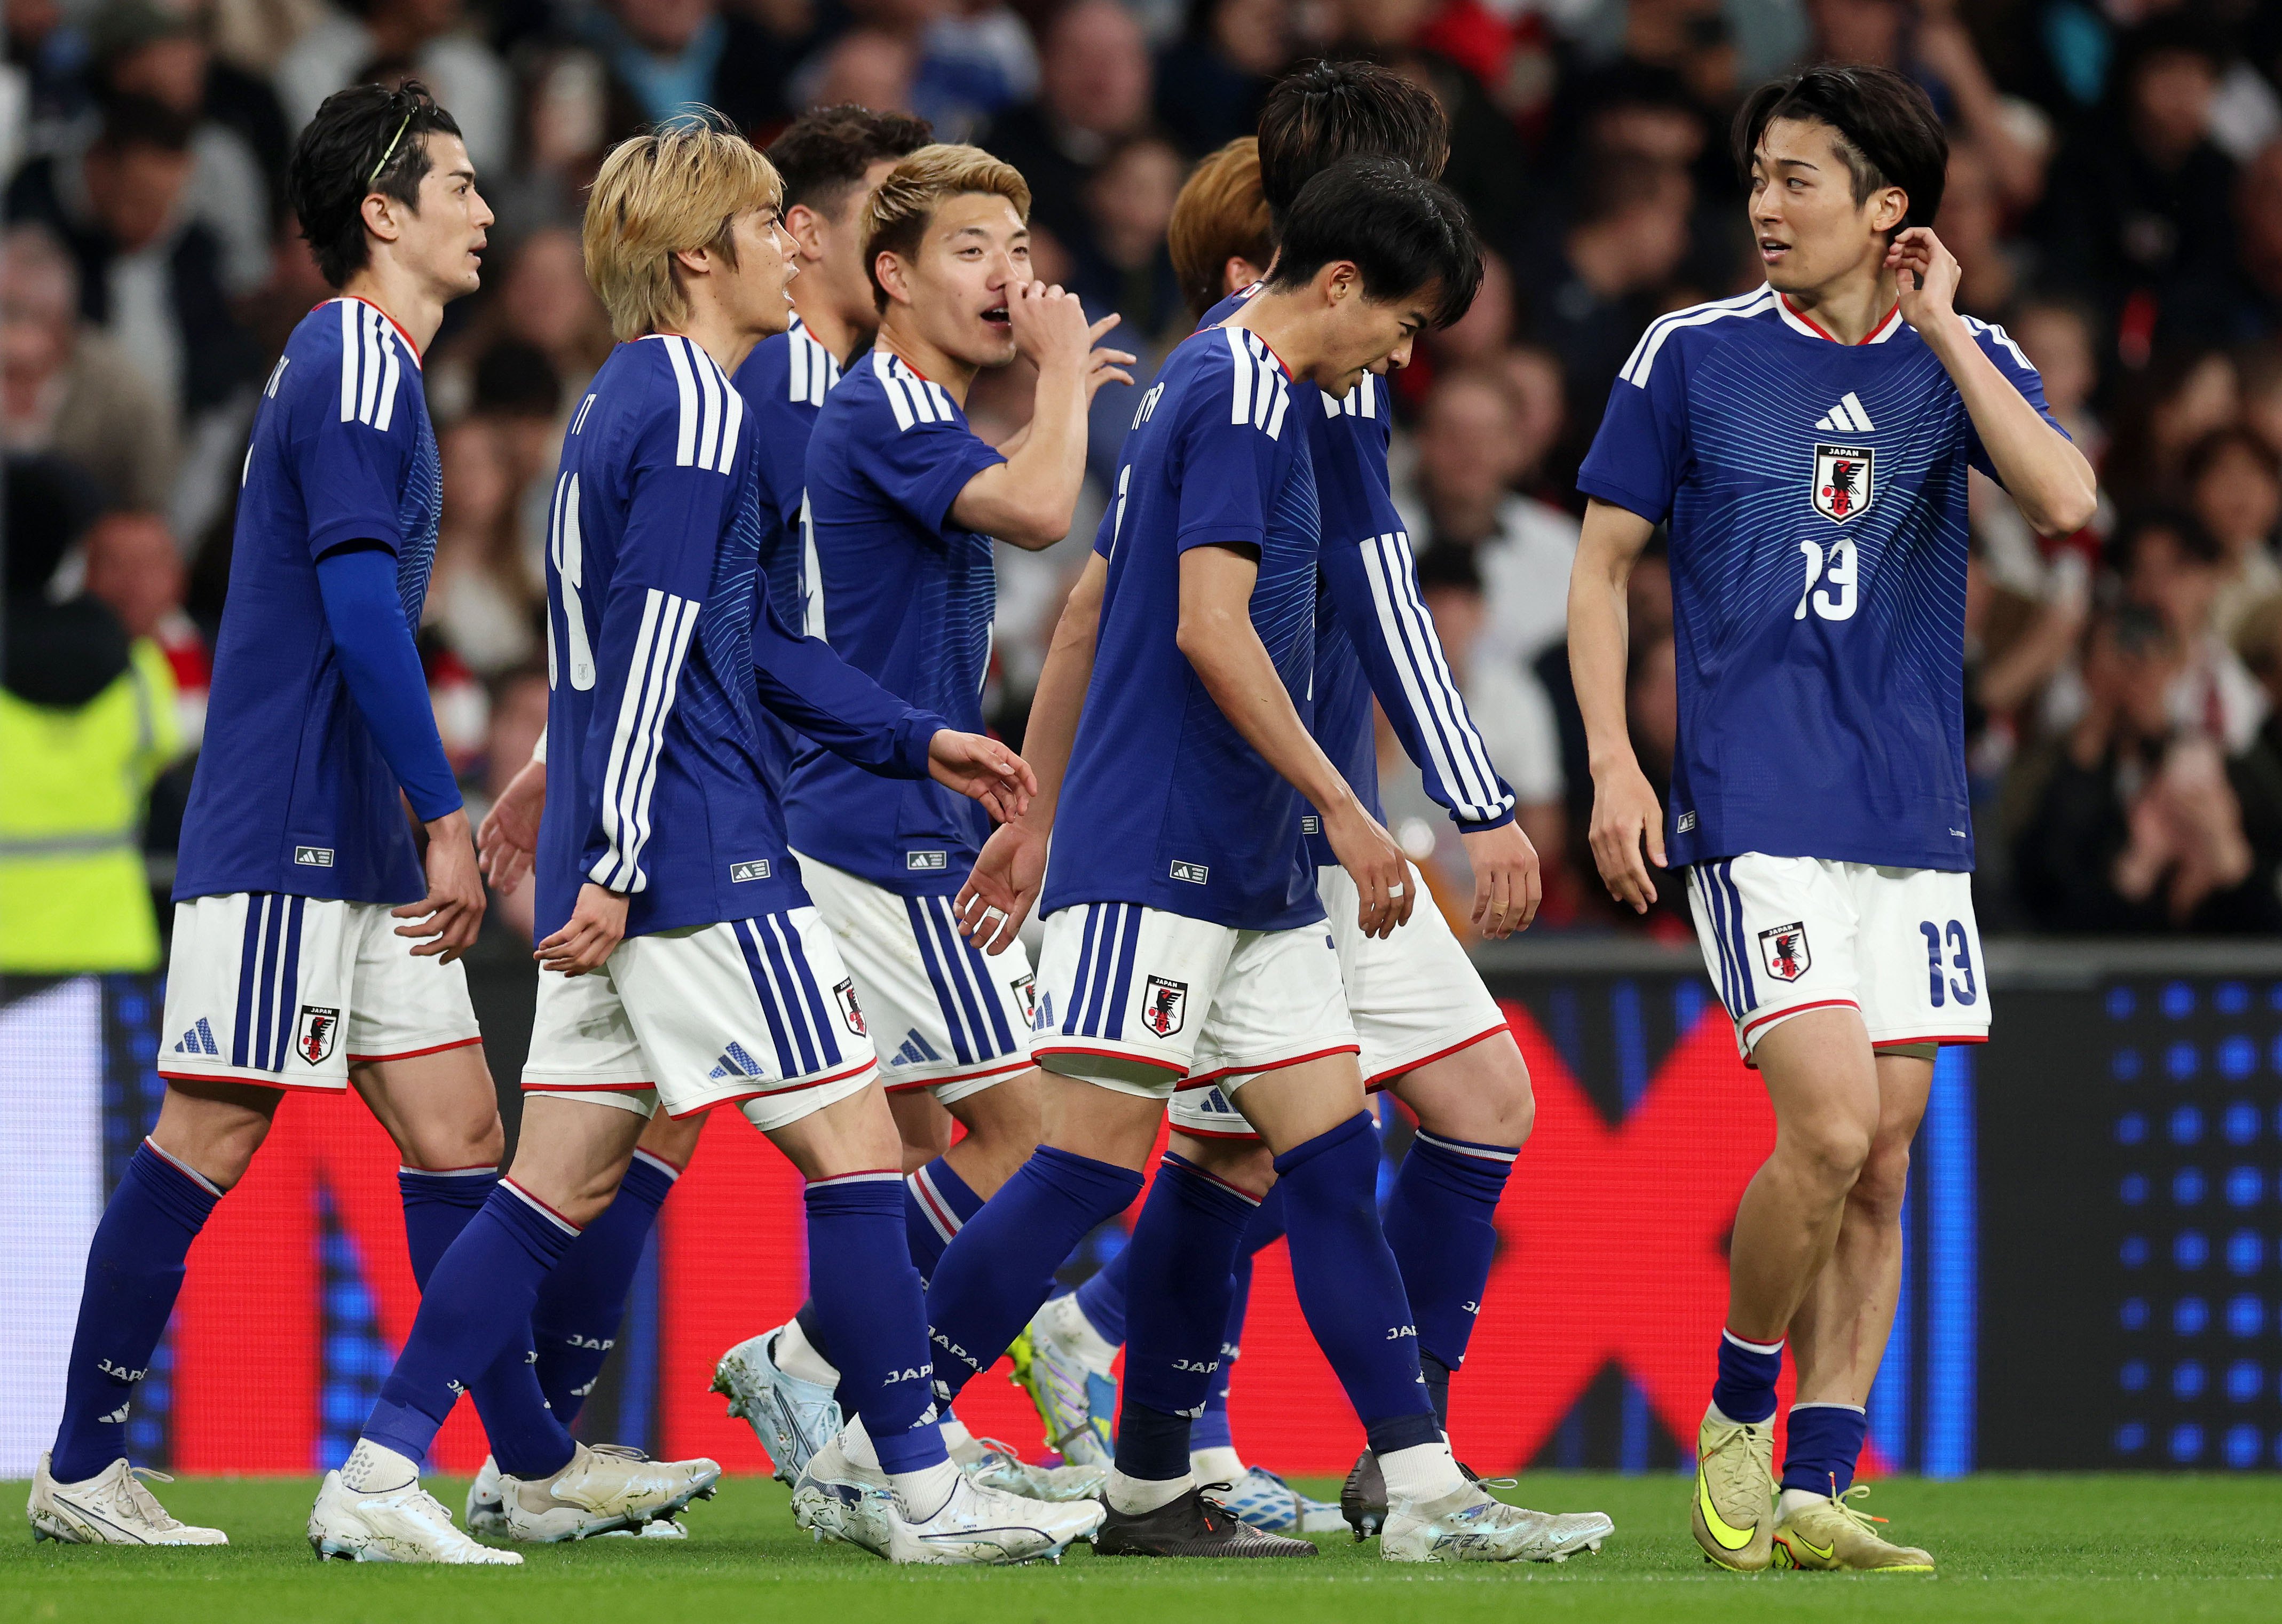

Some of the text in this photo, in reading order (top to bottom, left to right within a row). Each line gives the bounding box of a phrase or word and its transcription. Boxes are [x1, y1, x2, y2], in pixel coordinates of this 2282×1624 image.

[1828, 448, 1859, 457] JAPAN
[1827, 498, 1854, 511] JFA
[1794, 537, 1858, 621] 13
[1768, 924, 1794, 936] JAPAN
[1920, 920, 1977, 1008] 13
[1155, 978, 1178, 988] JAPAN
